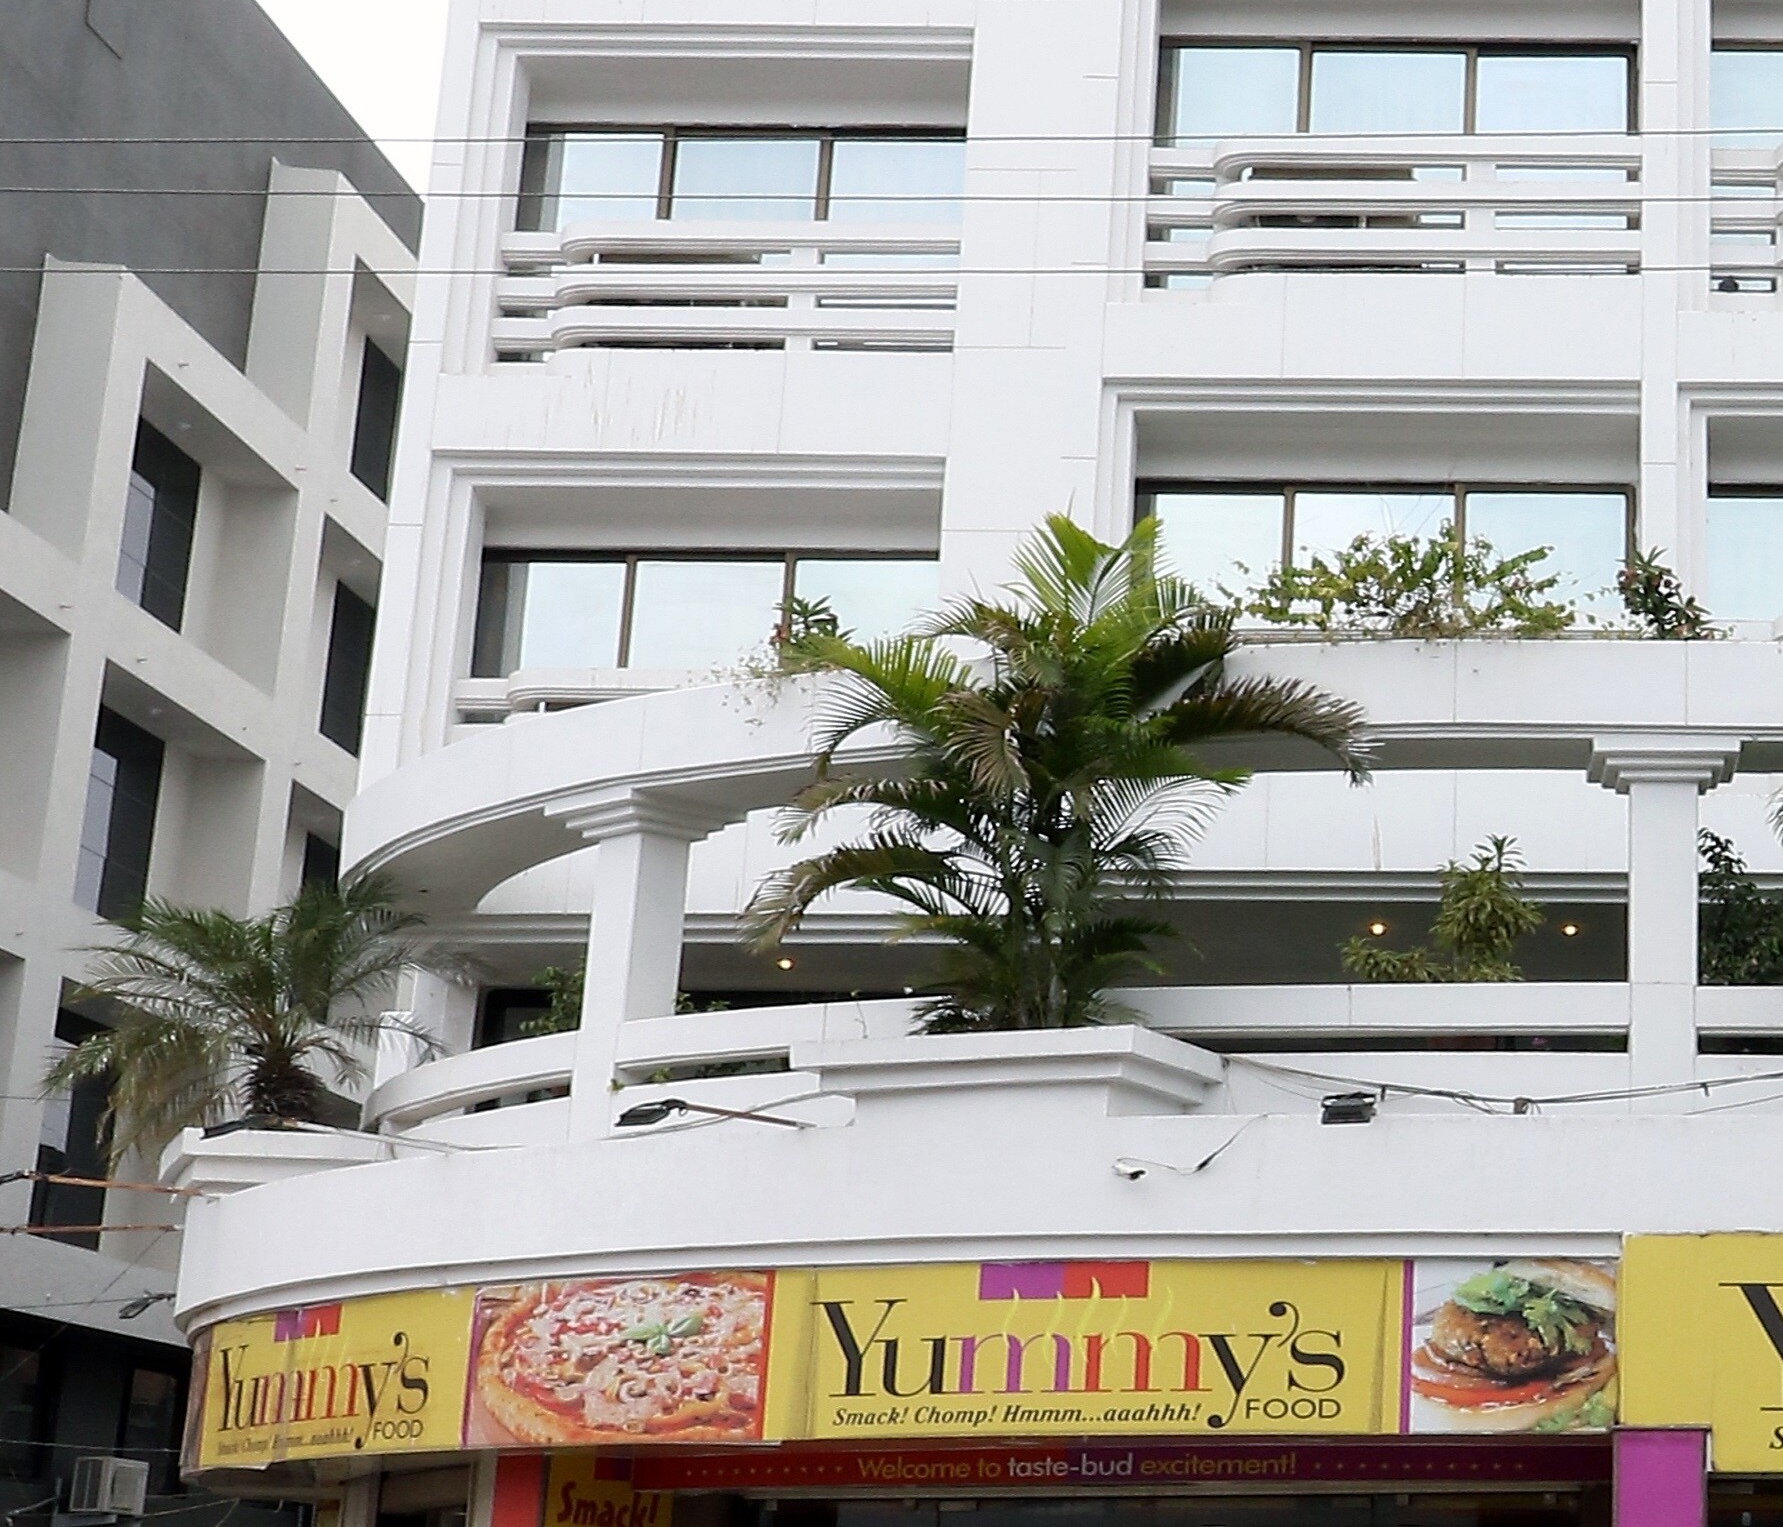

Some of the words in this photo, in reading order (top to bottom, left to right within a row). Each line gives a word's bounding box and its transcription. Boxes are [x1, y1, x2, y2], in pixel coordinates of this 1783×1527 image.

[810, 1298, 1346, 1429] Yummy's
[217, 1331, 430, 1449] Yummy's
[832, 1407, 908, 1426] Smack!
[913, 1405, 998, 1428] Chomp!
[1244, 1398, 1342, 1420] FOOD
[372, 1419, 424, 1440] FOOD
[858, 1457, 971, 1479] Welcome
[977, 1457, 1001, 1478] to
[1007, 1453, 1133, 1477] taste-bud
[1140, 1453, 1296, 1475] excitement!
[557, 1480, 660, 1527] Smack!
